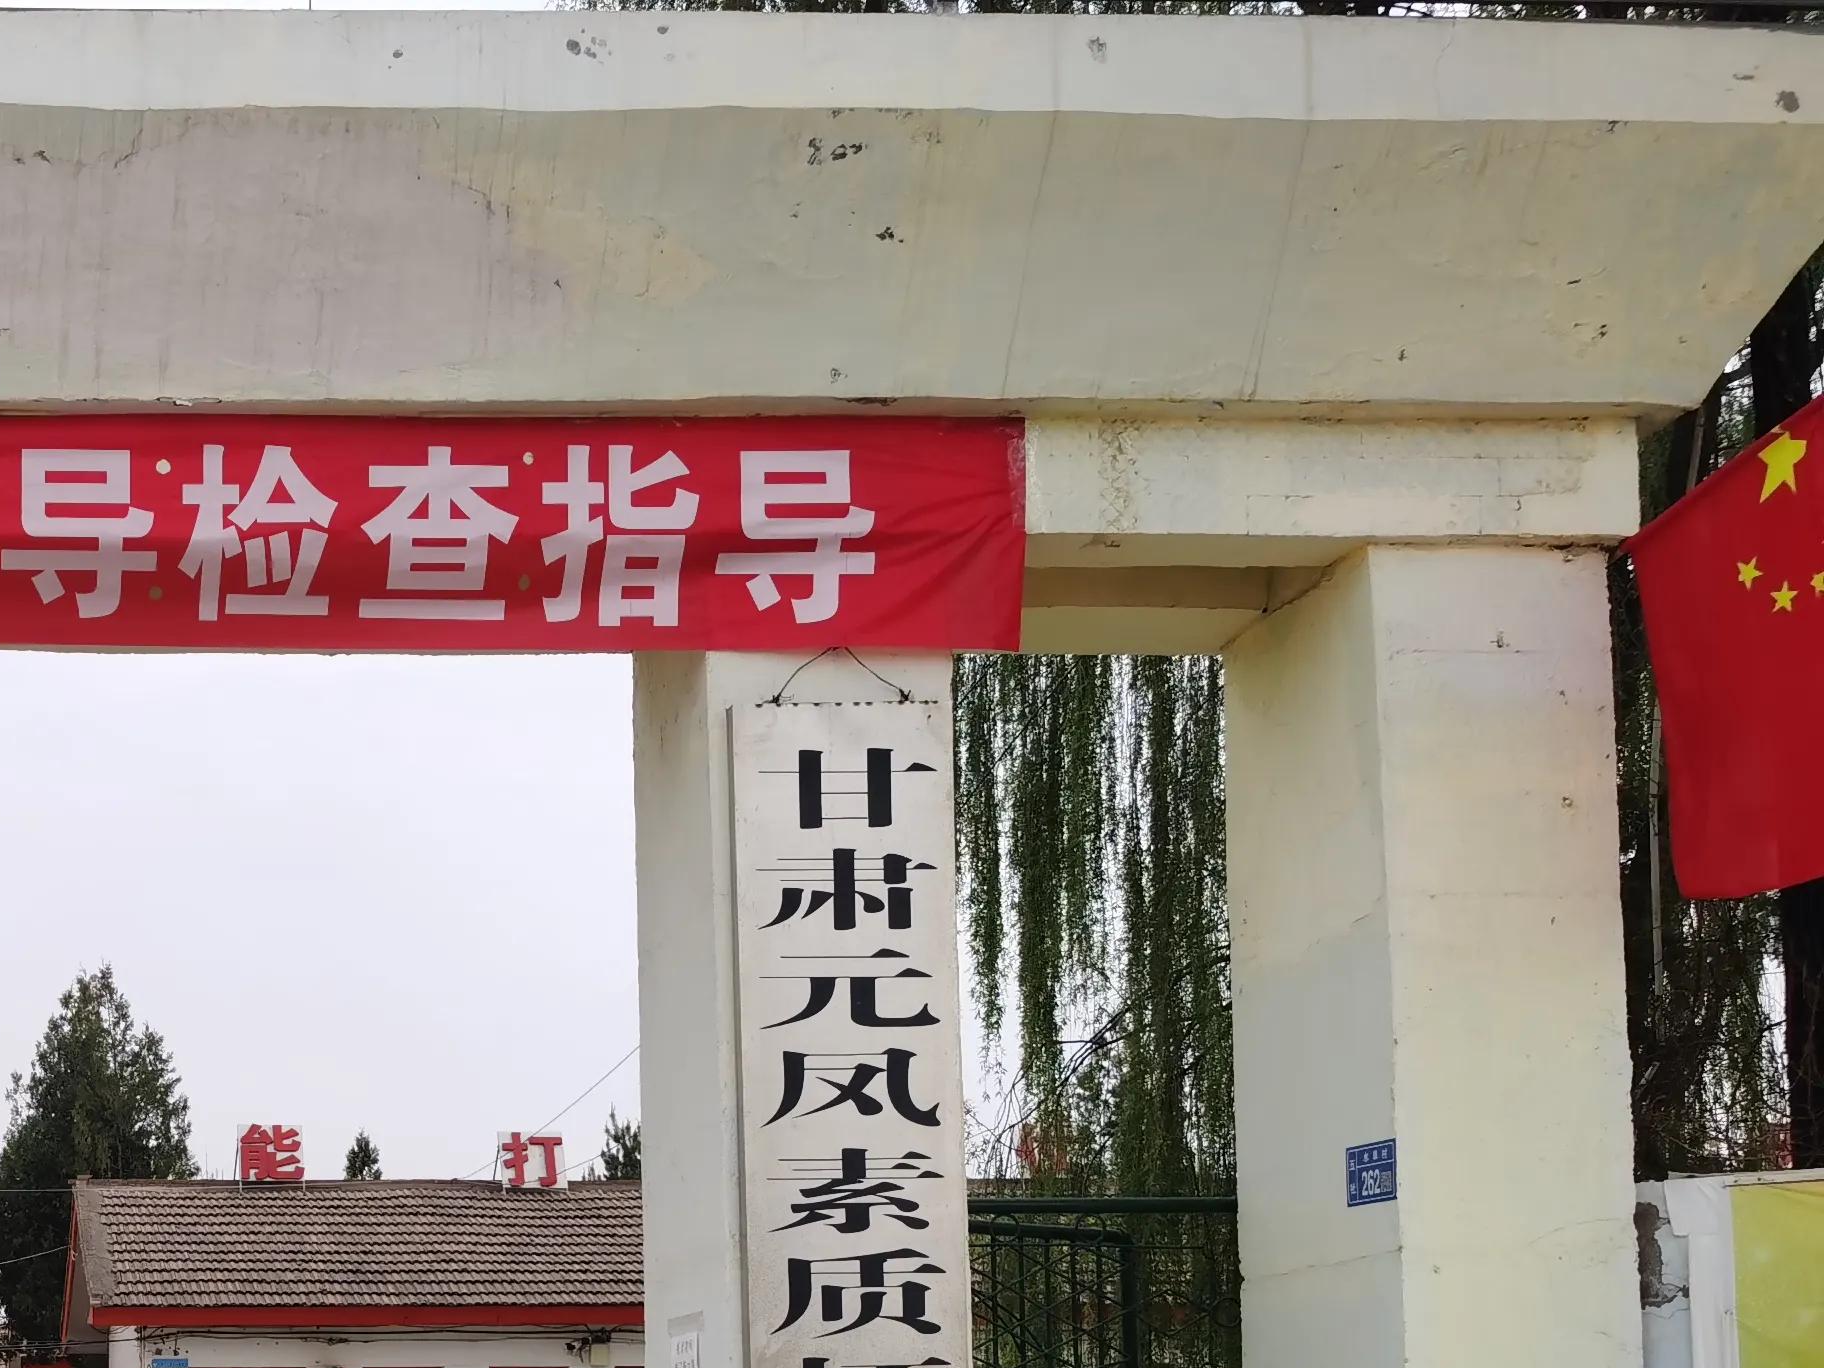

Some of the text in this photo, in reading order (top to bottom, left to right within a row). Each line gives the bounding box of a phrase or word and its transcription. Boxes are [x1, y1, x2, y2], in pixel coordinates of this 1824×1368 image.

[240, 1124, 305, 1181] 能
[502, 1132, 563, 1187] 打
[1361, 1168, 1381, 1196] 262
